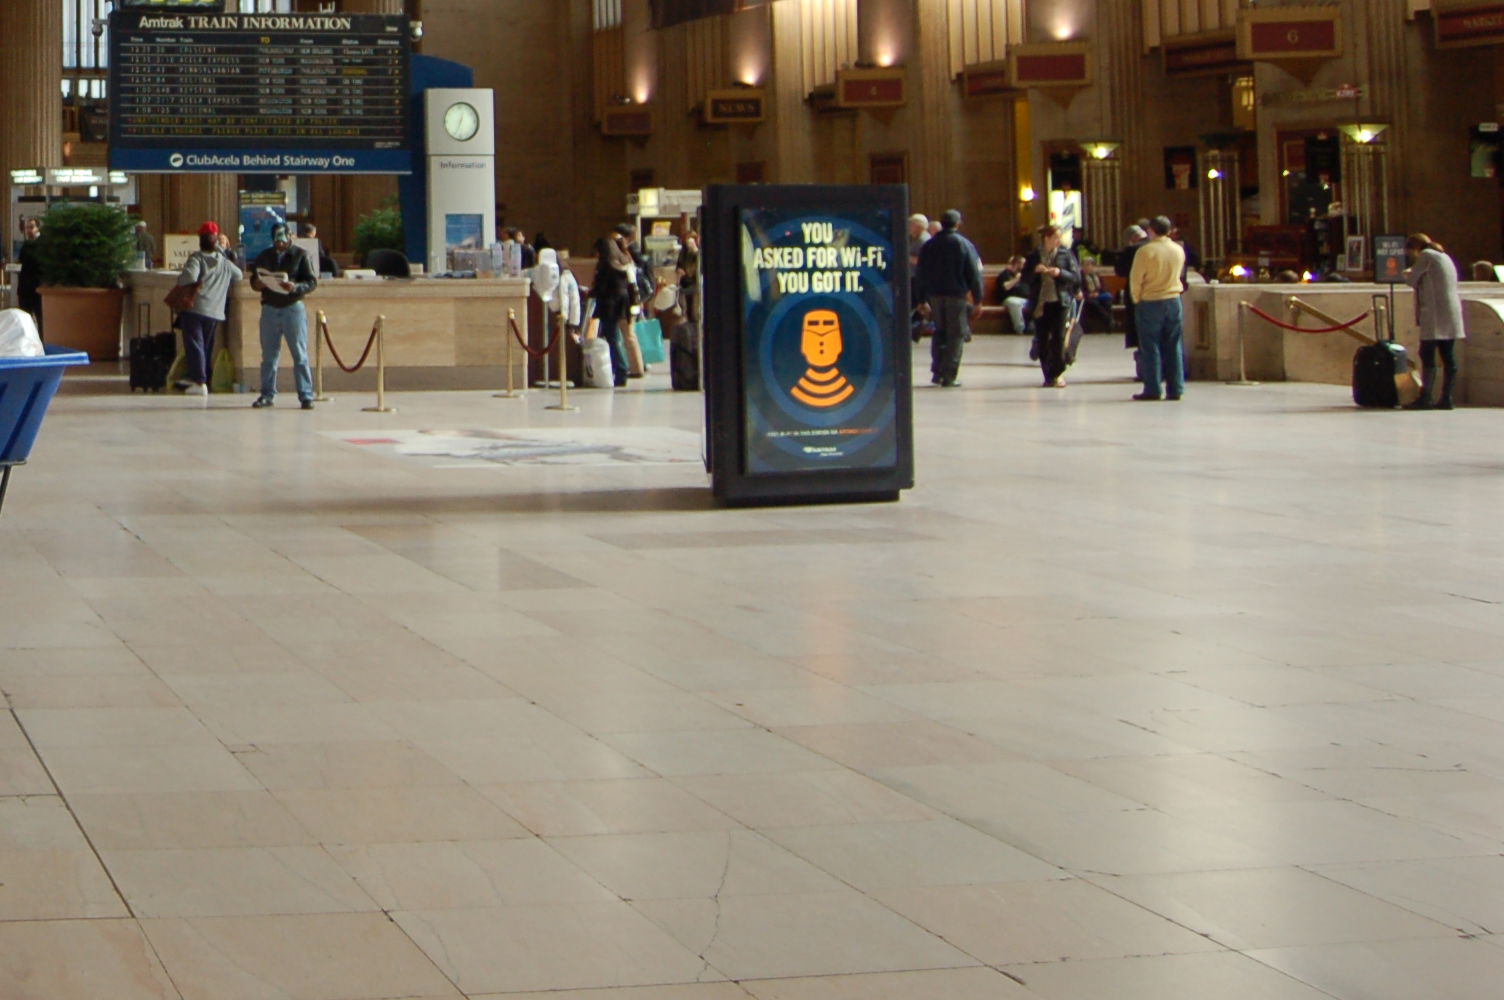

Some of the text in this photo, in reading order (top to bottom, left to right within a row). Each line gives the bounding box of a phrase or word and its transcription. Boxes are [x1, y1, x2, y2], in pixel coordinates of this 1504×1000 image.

[139, 15, 351, 31] Amtrak TRAIN INFORMATION
[1286, 29, 1299, 44] 6
[718, 101, 756, 113] NEWS
[186, 154, 355, 169] ClubAcela Behind Stairway One
[802, 222, 833, 244] YOU
[754, 246, 886, 271] ASKED FOR Wi-Fi,
[777, 271, 864, 294] YOU GOT IT.
